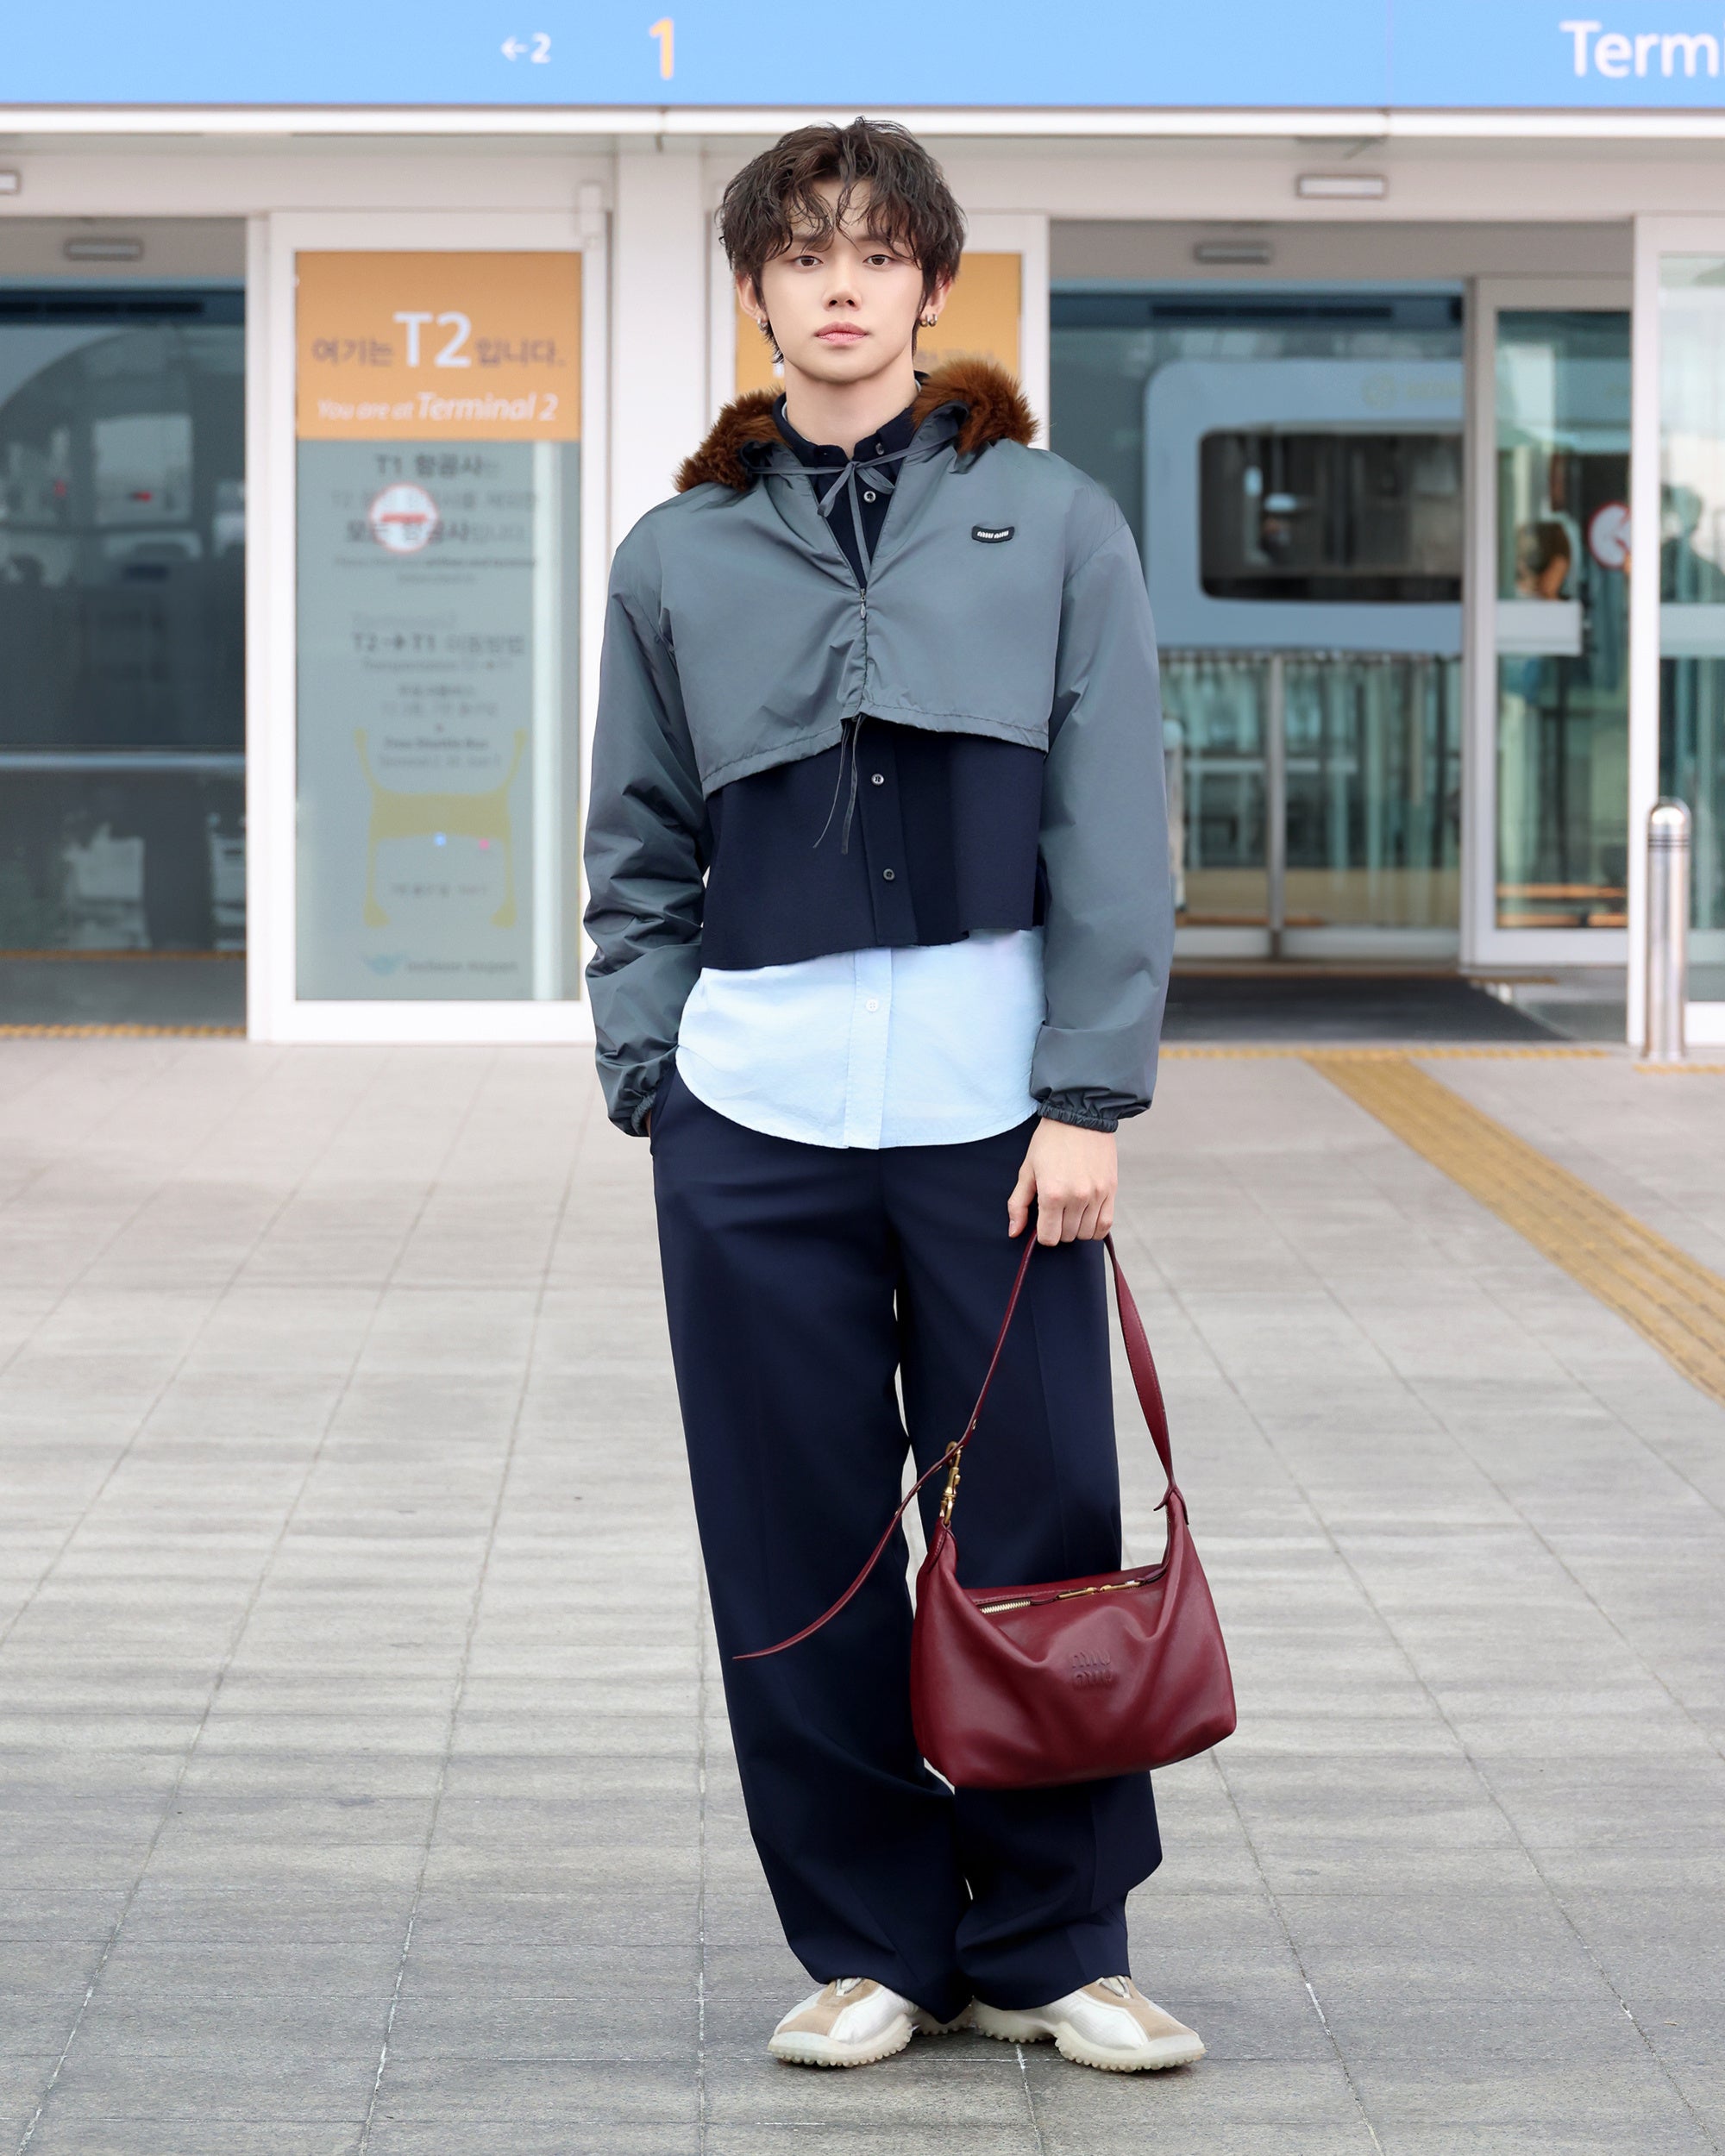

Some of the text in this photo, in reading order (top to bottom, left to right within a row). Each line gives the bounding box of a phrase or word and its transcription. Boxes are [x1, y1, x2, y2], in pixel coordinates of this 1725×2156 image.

[530, 32, 552, 64] 2
[649, 17, 674, 80] 1
[1559, 20, 1725, 78] Term
[311, 337, 392, 368] 여기는
[393, 311, 472, 367] T2
[317, 392, 559, 421] You are at Terminal 2
